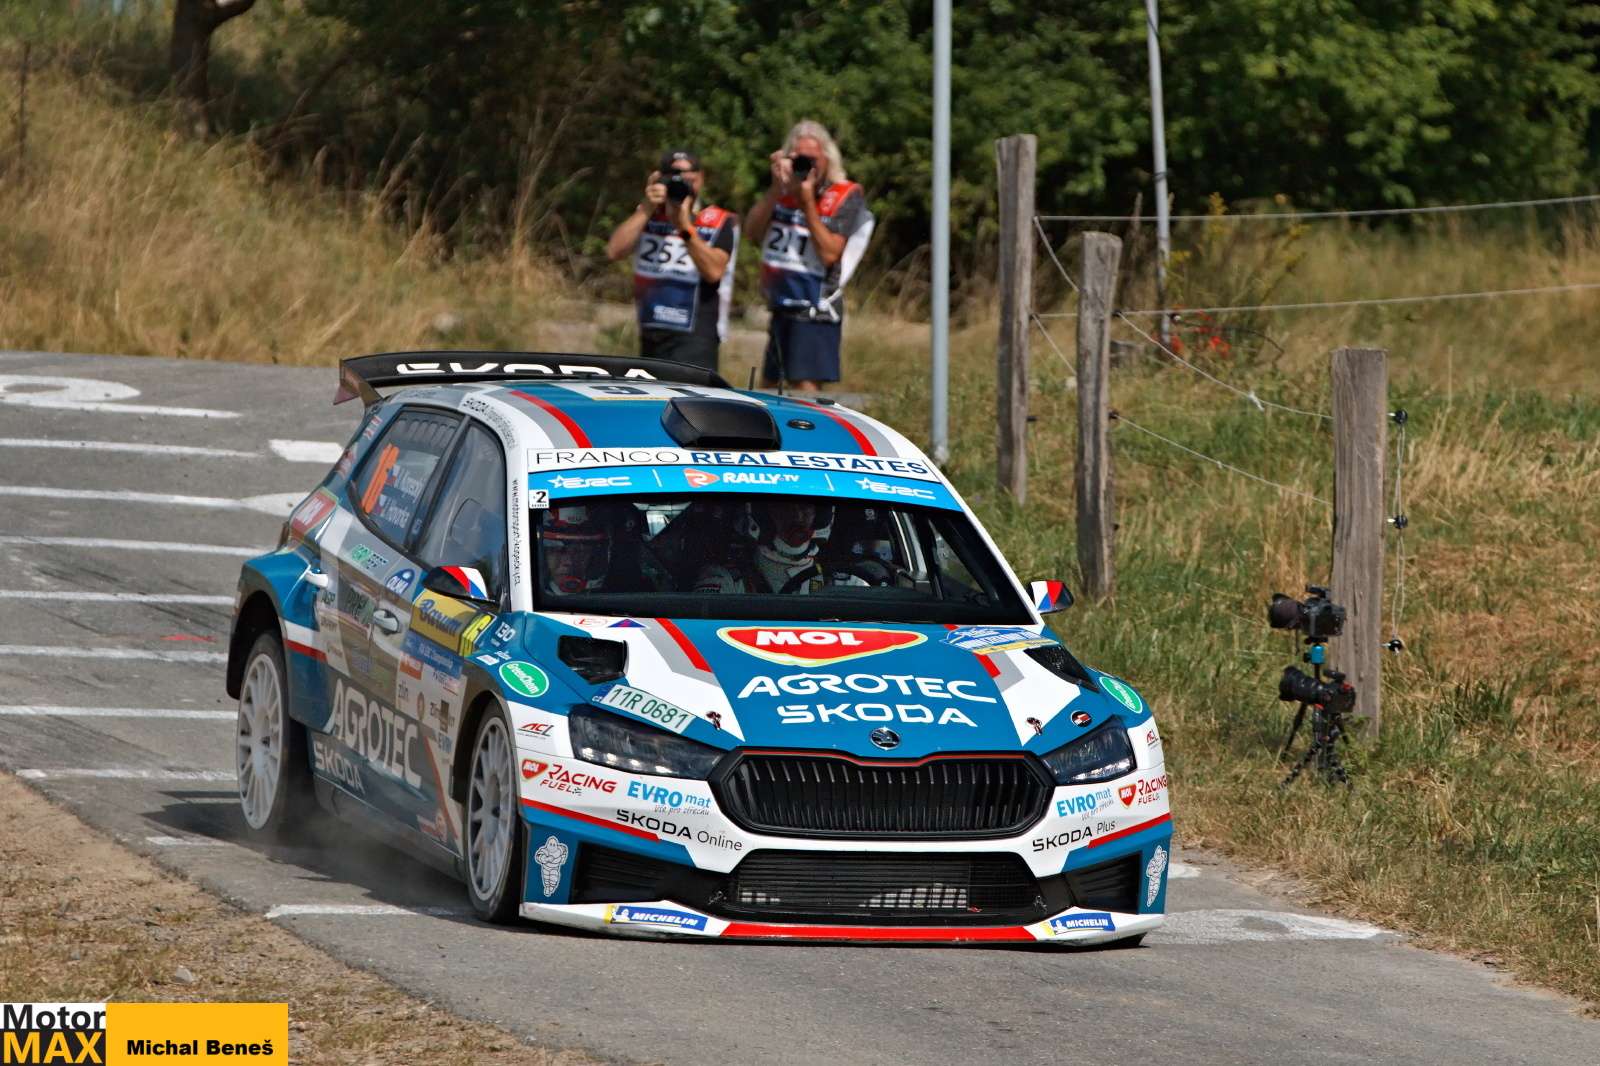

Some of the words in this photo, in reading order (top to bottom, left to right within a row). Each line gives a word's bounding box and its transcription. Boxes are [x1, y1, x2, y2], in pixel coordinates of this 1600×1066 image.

[639, 239, 688, 265] 252
[536, 450, 680, 465] FRANCO
[691, 451, 781, 466] REAL
[786, 454, 928, 475] ESTATES
[755, 630, 864, 647] MOL
[737, 672, 998, 704] AGROTEC
[608, 687, 643, 710] 11R
[640, 699, 689, 729] 0681
[322, 678, 422, 789] AGROTEC
[548, 763, 618, 794] RACING
[627, 780, 683, 808] EVRO
[684, 794, 711, 808] mat
[1056, 793, 1096, 818] EVRO
[1095, 788, 1113, 801] mat
[697, 830, 743, 851] Online
[1096, 820, 1117, 835] Plus
[631, 912, 699, 927] MICHELIN
[1066, 917, 1109, 928] MICHELIN
